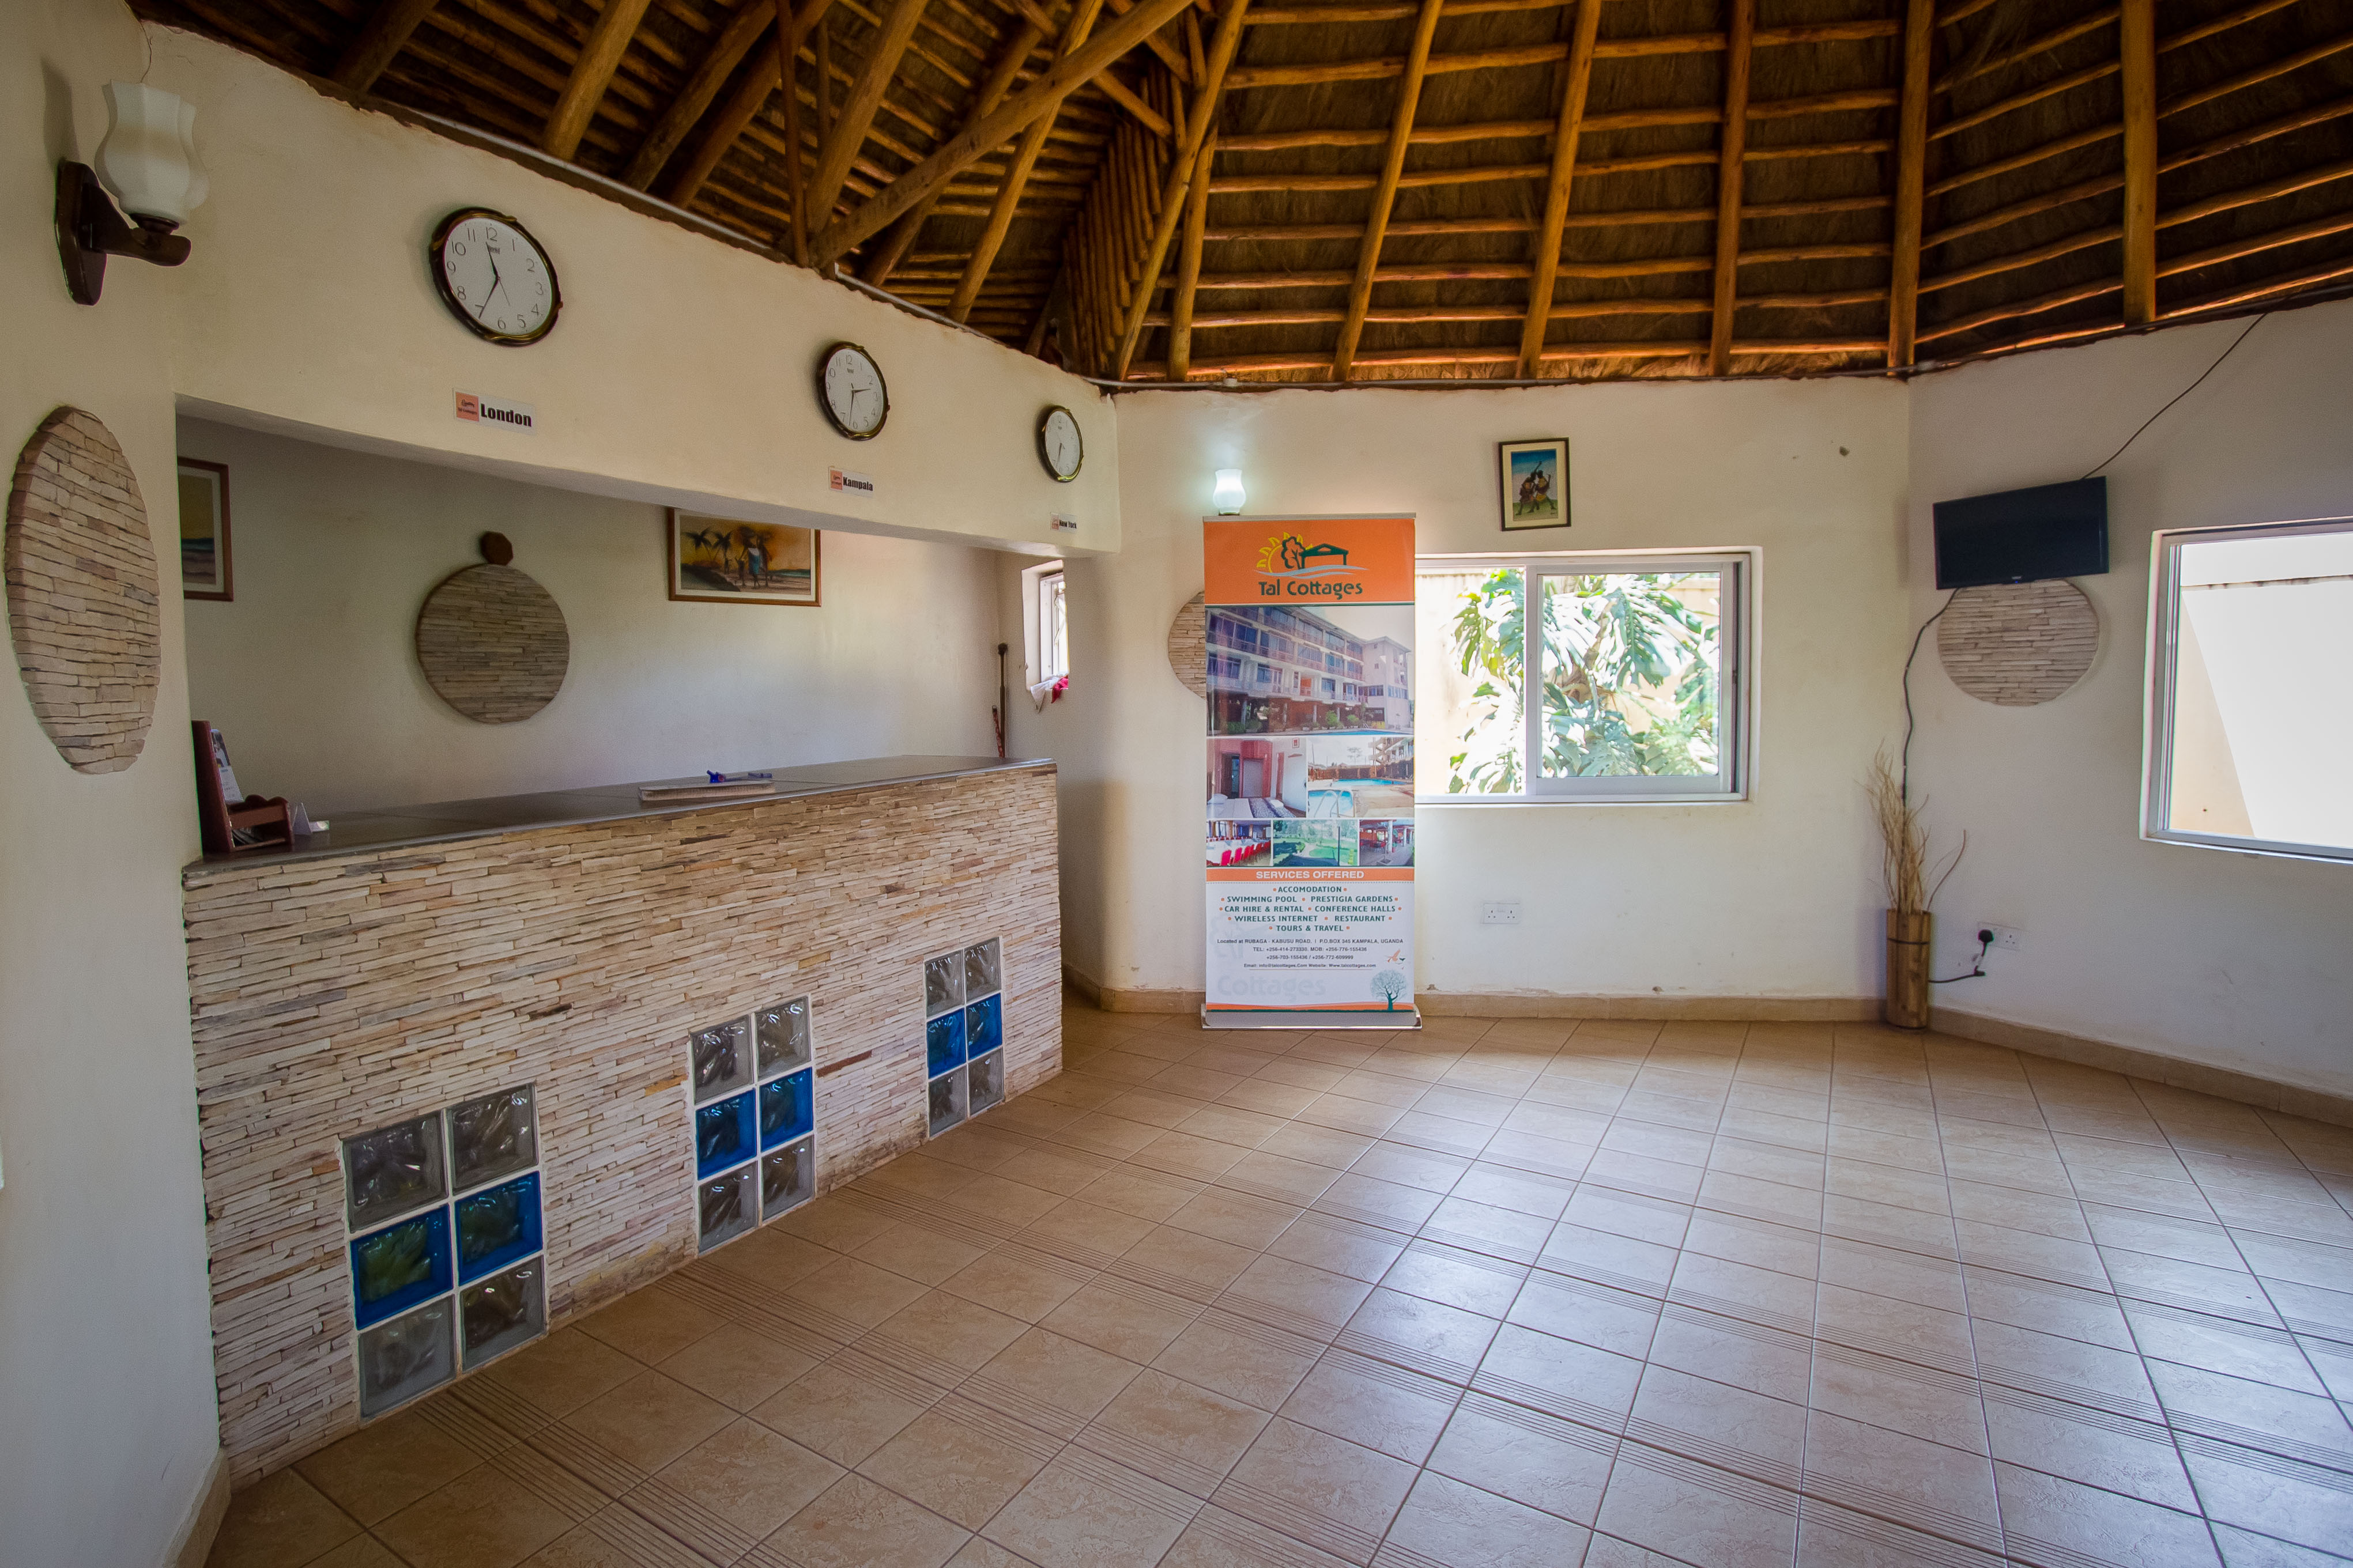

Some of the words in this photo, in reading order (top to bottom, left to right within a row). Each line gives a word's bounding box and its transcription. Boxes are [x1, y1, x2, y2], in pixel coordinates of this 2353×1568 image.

[467, 228, 476, 242] 11
[486, 226, 497, 242] 12
[452, 240, 466, 255] 10
[512, 239, 515, 252] 1
[447, 260, 456, 273] 9
[526, 258, 535, 273] 2
[457, 286, 466, 300] 8
[535, 282, 544, 295] 3
[531, 303, 539, 316] 4
[497, 316, 506, 330] 6
[517, 314, 526, 328] 5
[835, 356, 841, 367] 11
[845, 354, 853, 365] 12
[828, 368, 836, 377] 10
[867, 375, 873, 385] 2
[872, 391, 878, 401] 3
[831, 399, 836, 410] 8
[480, 403, 532, 428] London
[840, 411, 846, 422] 7
[870, 407, 876, 416] 4
[853, 420, 858, 429] 6
[863, 416, 869, 427] 5
[843, 476, 873, 492] Kampala
[1059, 519, 1068, 528] New
[1068, 520, 1077, 529] York
[1258, 579, 1280, 596] Tal
[1287, 580, 1363, 600] Cottages
[1256, 871, 1310, 879] SERVICES
[1217, 974, 1326, 1003] Cottages
